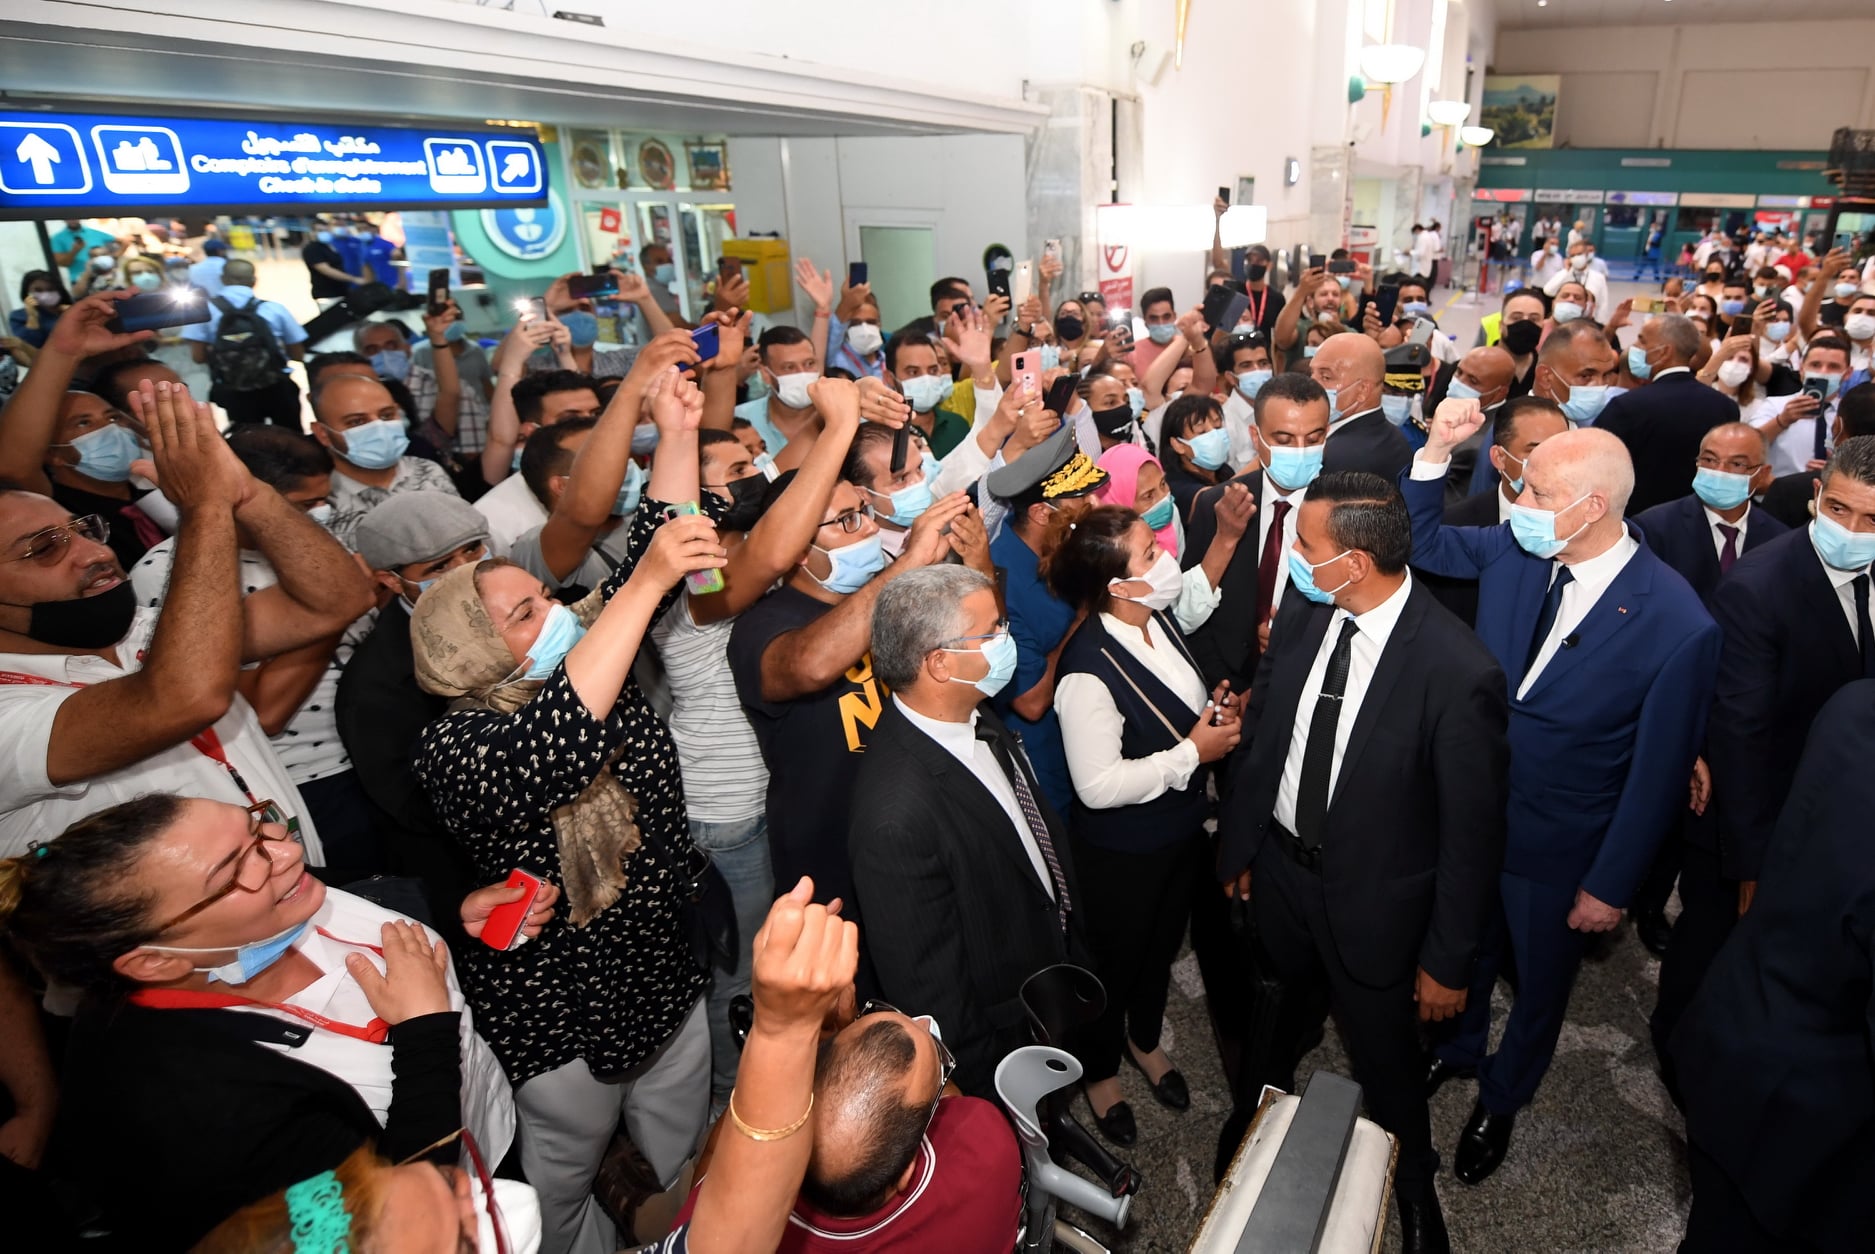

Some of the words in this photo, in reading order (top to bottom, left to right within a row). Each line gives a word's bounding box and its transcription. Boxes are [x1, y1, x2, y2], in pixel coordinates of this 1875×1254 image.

[242, 131, 321, 156] التسجيل
[191, 155, 292, 176] Comptoirs
[292, 157, 428, 177] d'enregistrement
